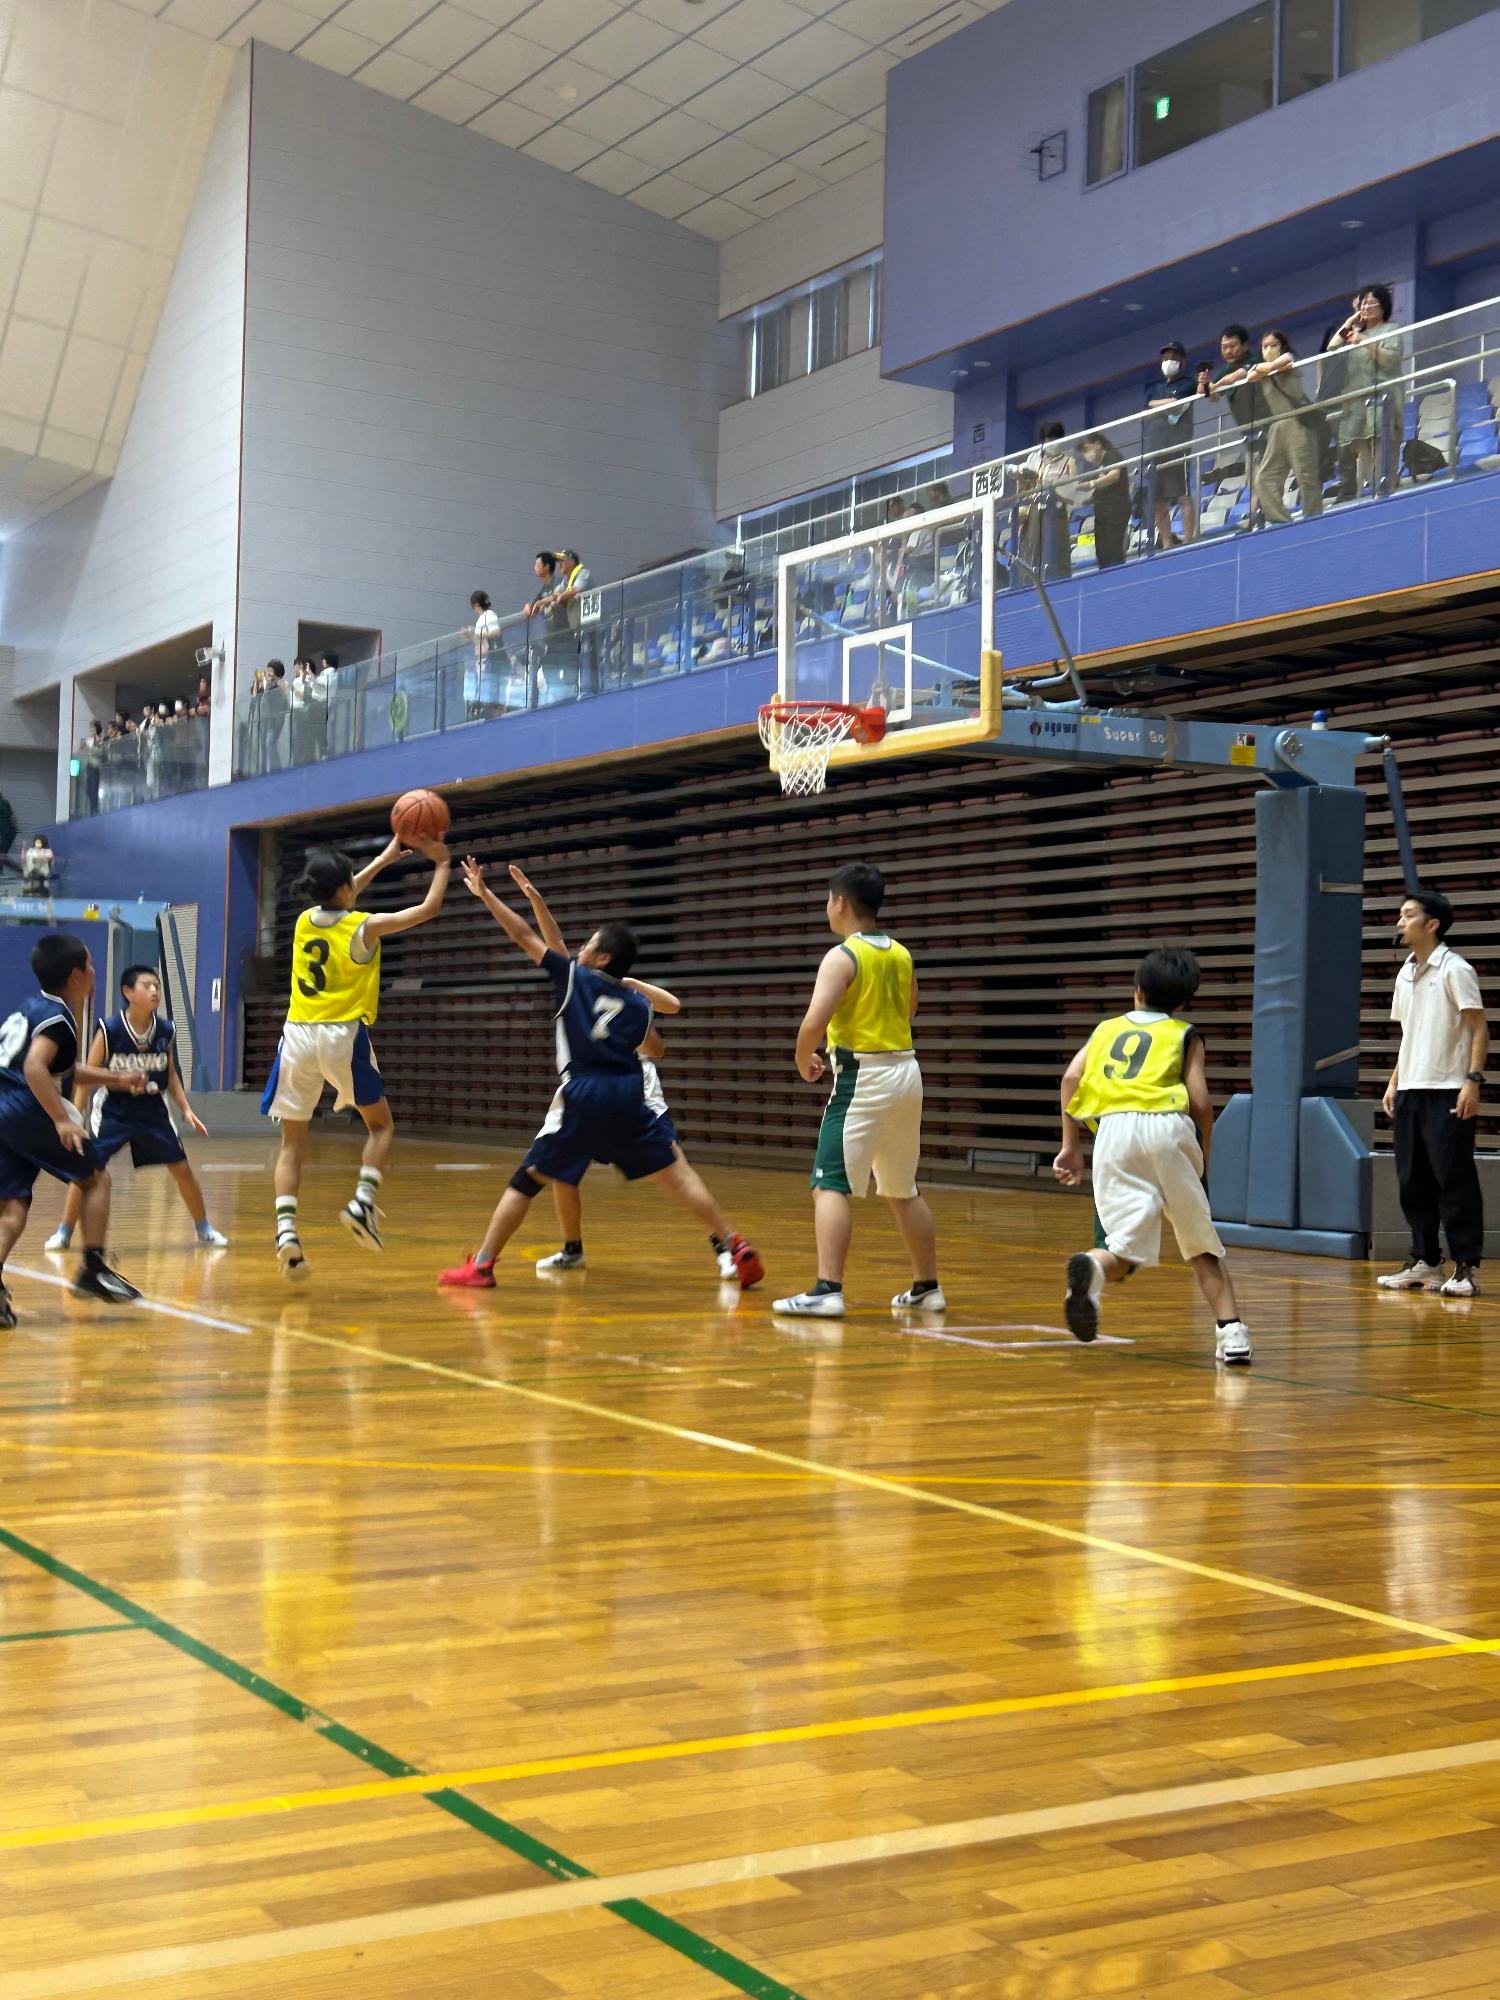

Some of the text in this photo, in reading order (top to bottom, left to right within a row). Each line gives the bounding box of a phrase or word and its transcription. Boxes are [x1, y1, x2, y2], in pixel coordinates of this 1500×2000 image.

[1103, 726, 1141, 742] Super
[297, 938, 330, 997] 3
[591, 995, 625, 1041] 7
[1103, 1030, 1153, 1080] 9
